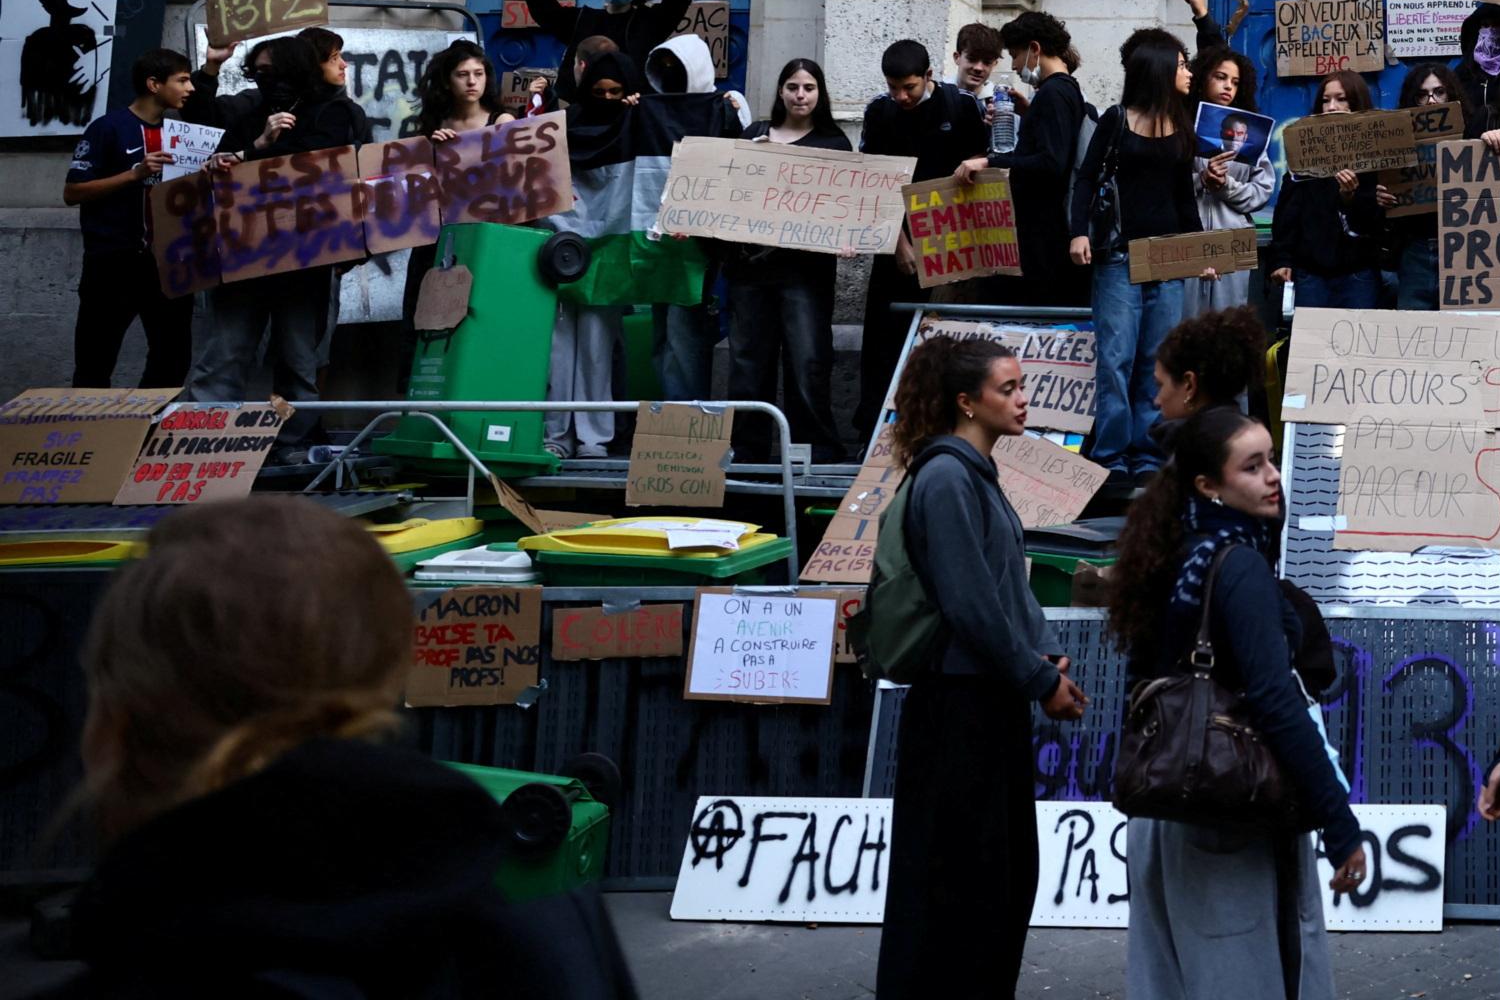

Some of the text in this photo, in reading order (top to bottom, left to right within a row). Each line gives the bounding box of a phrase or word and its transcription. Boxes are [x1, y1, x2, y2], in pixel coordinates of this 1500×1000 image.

[1278, 2, 1305, 27] ON
[1311, 0, 1347, 22] VEUT
[1277, 23, 1358, 43] LE BAC EUX
[1277, 41, 1377, 58] APPELLENT LA
[1315, 55, 1350, 74] BAC
[168, 122, 191, 134] AJD
[482, 121, 559, 161] LES
[746, 162, 767, 177] DE
[670, 175, 753, 202] QUE DE
[911, 190, 944, 211] LA
[910, 200, 1013, 238] EMMERDE
[1203, 240, 1251, 257] PAS RN
[1443, 270, 1494, 306] LES
[1022, 332, 1097, 364] LYCÉES
[1331, 319, 1380, 360] ON
[1395, 325, 1481, 360] VEUT
[1311, 363, 1468, 406] PARCOURS
[235, 411, 257, 428] ON
[1354, 415, 1478, 454] PAS UN
[12, 451, 94, 466] FRAGILE
[133, 463, 169, 484] ON
[196, 461, 246, 479] VEUT
[20, 485, 64, 504] PAS
[156, 480, 207, 502] PAS
[635, 476, 712, 495] GROS CON
[420, 591, 521, 621] MACRON
[724, 599, 802, 616] ON A UN
[484, 622, 516, 642] TA
[560, 608, 681, 650] COLÈRE
[465, 645, 496, 665] PAS
[503, 644, 541, 666] NOS
[714, 637, 725, 654] A
[743, 653, 775, 667] PAS A
[728, 669, 791, 690] SUBIR
